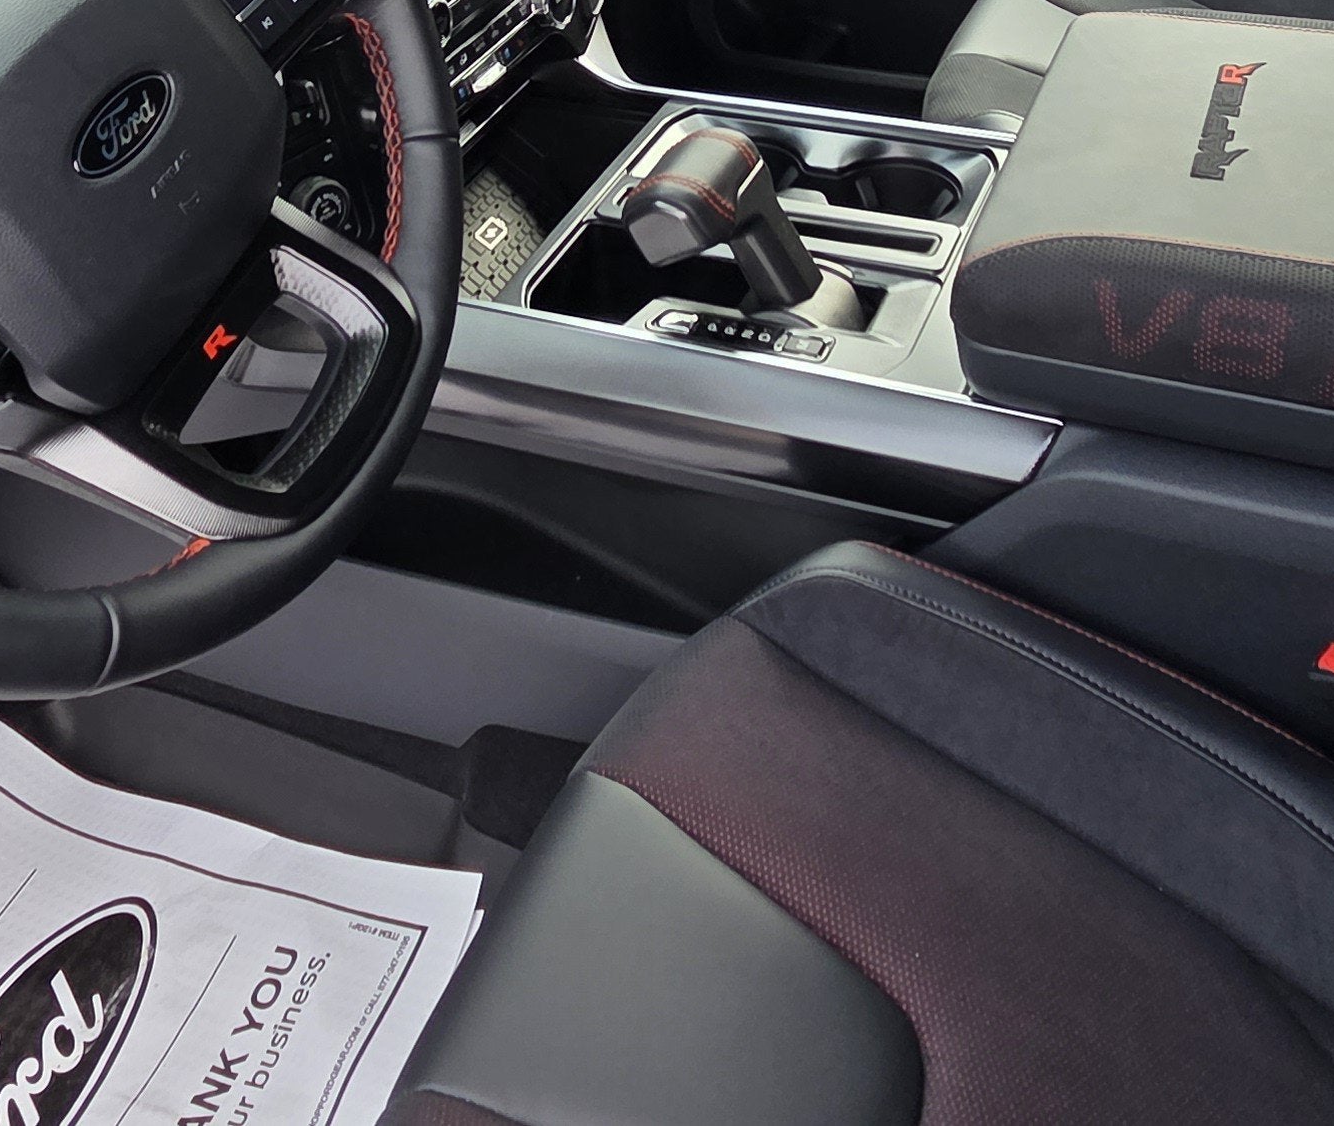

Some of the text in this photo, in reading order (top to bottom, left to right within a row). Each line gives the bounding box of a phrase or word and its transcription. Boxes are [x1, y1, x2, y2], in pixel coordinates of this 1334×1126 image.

[96, 89, 156, 160] Ford
[1190, 61, 1267, 181] RAPTOR
[202, 323, 239, 360] R
[1093, 278, 1295, 380] V8
[231, 945, 299, 1038] YOU
[244, 951, 332, 1090] business.
[364, 992, 383, 1015] CALL
